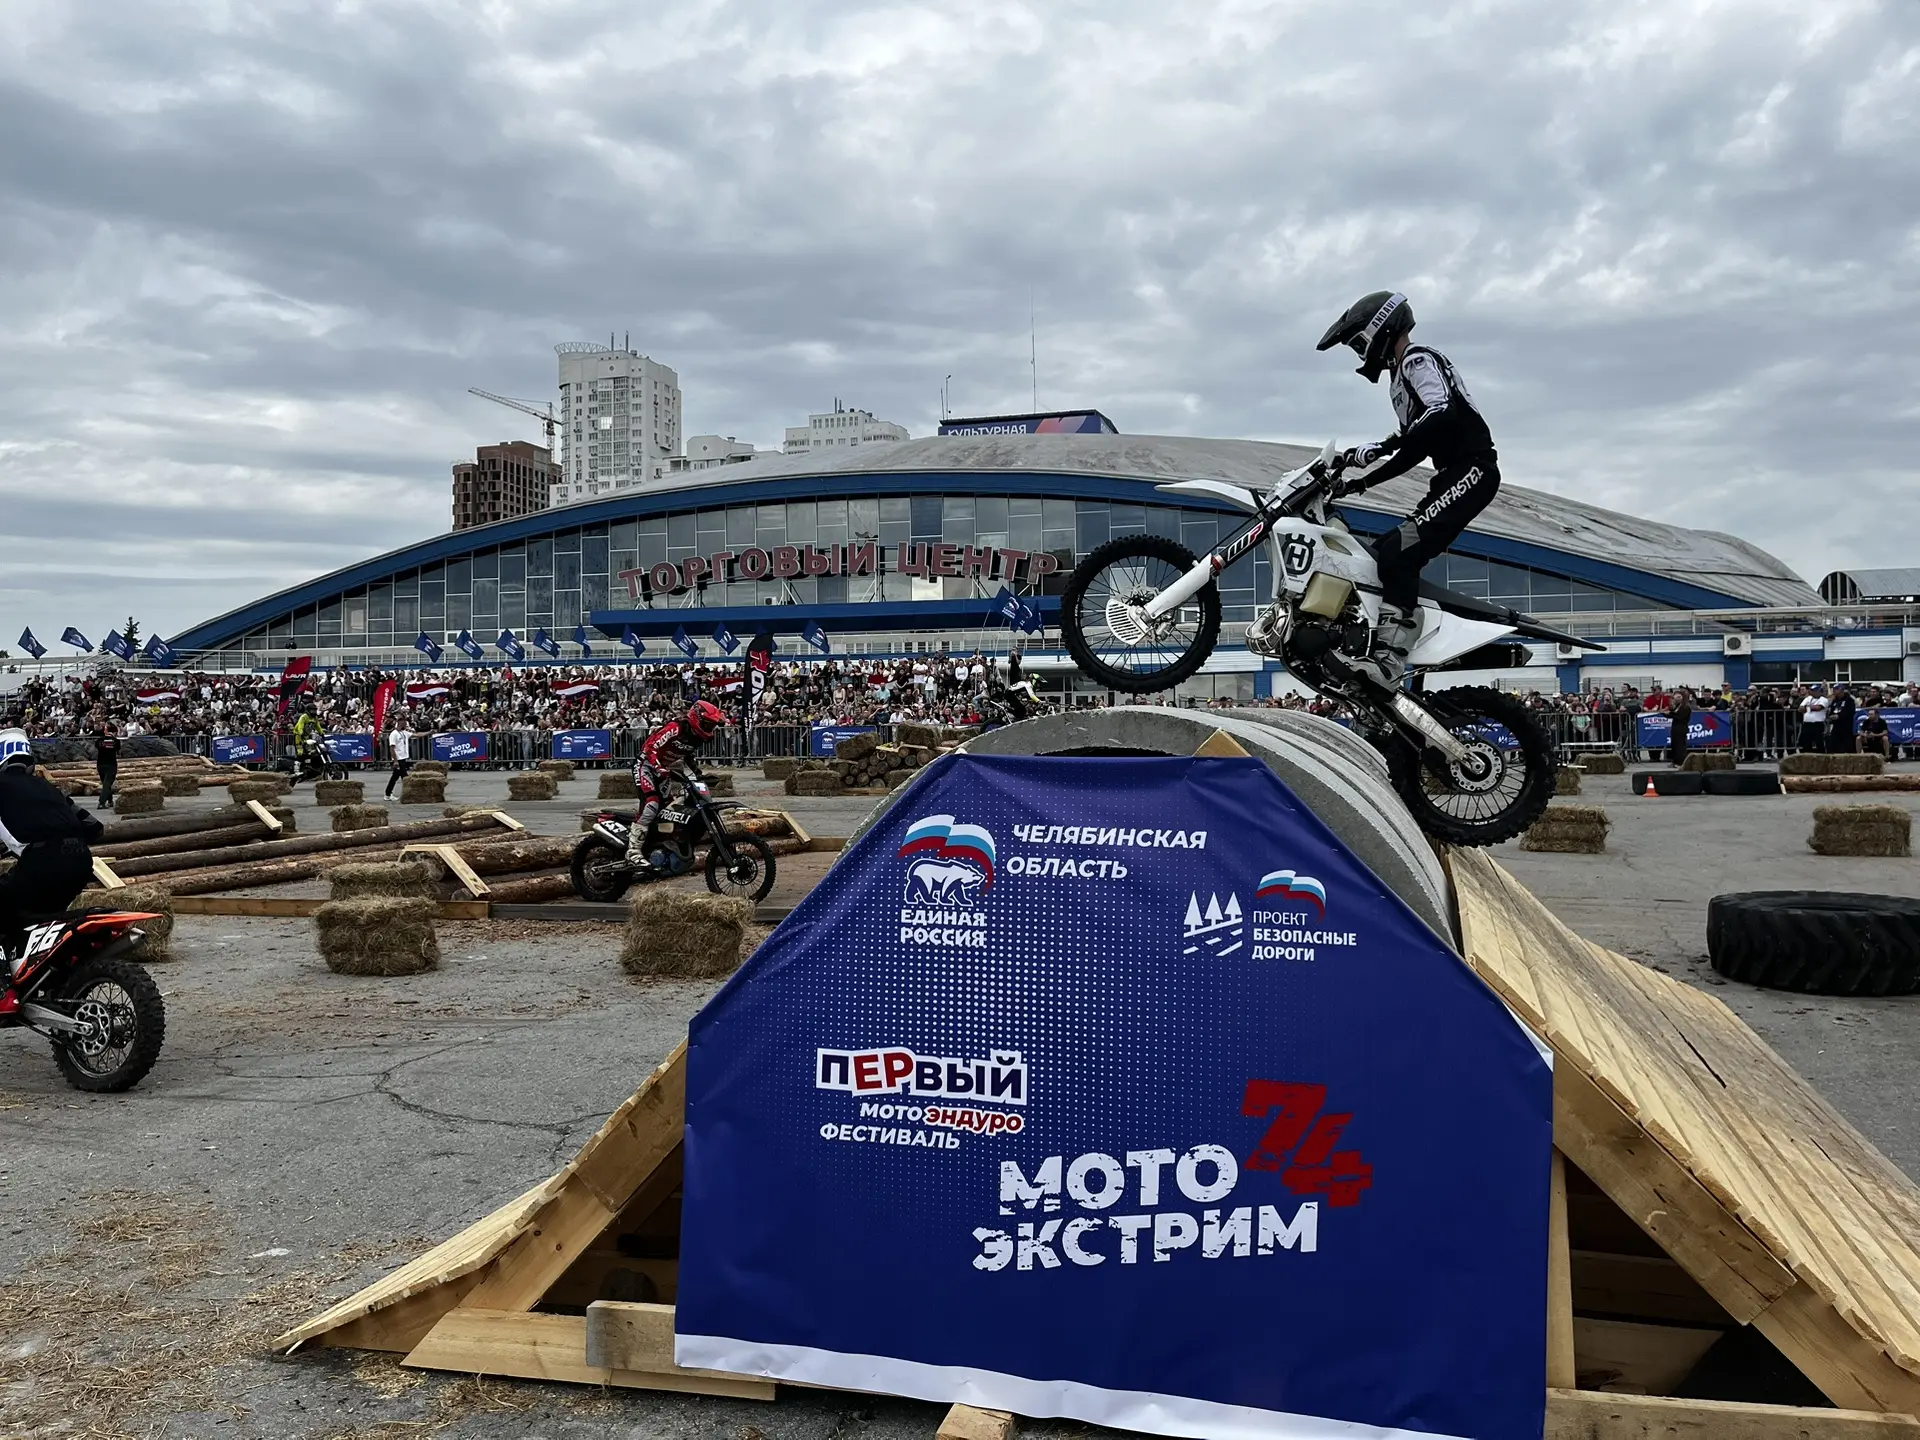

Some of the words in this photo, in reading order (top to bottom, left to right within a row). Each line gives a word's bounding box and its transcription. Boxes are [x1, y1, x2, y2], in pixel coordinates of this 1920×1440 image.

[617, 533, 877, 599] ТОРГОВЫЙ
[896, 541, 1059, 585] ЦЕНТР
[1013, 824, 1208, 849] ЧЕЛЯБИНСКАЯ
[1006, 856, 1128, 879] ОБЛАСТЬ
[901, 909, 987, 927] ЕДИНАЯ
[1253, 910, 1308, 926] ПРОЕКТ
[901, 927, 987, 947] РОССИЯ
[1253, 928, 1357, 946] БЕЗОПАСНЫЕ
[1251, 945, 1316, 962] ДОРОГИ
[818, 1048, 1026, 1103] ПЕРВЫЙ
[819, 1122, 961, 1150] ФЕСТИВАЛЬ
[1241, 1078, 1374, 1208] 74
[999, 1143, 1239, 1216] МОТО
[972, 1201, 1319, 1272] ЭКСТРИМ
